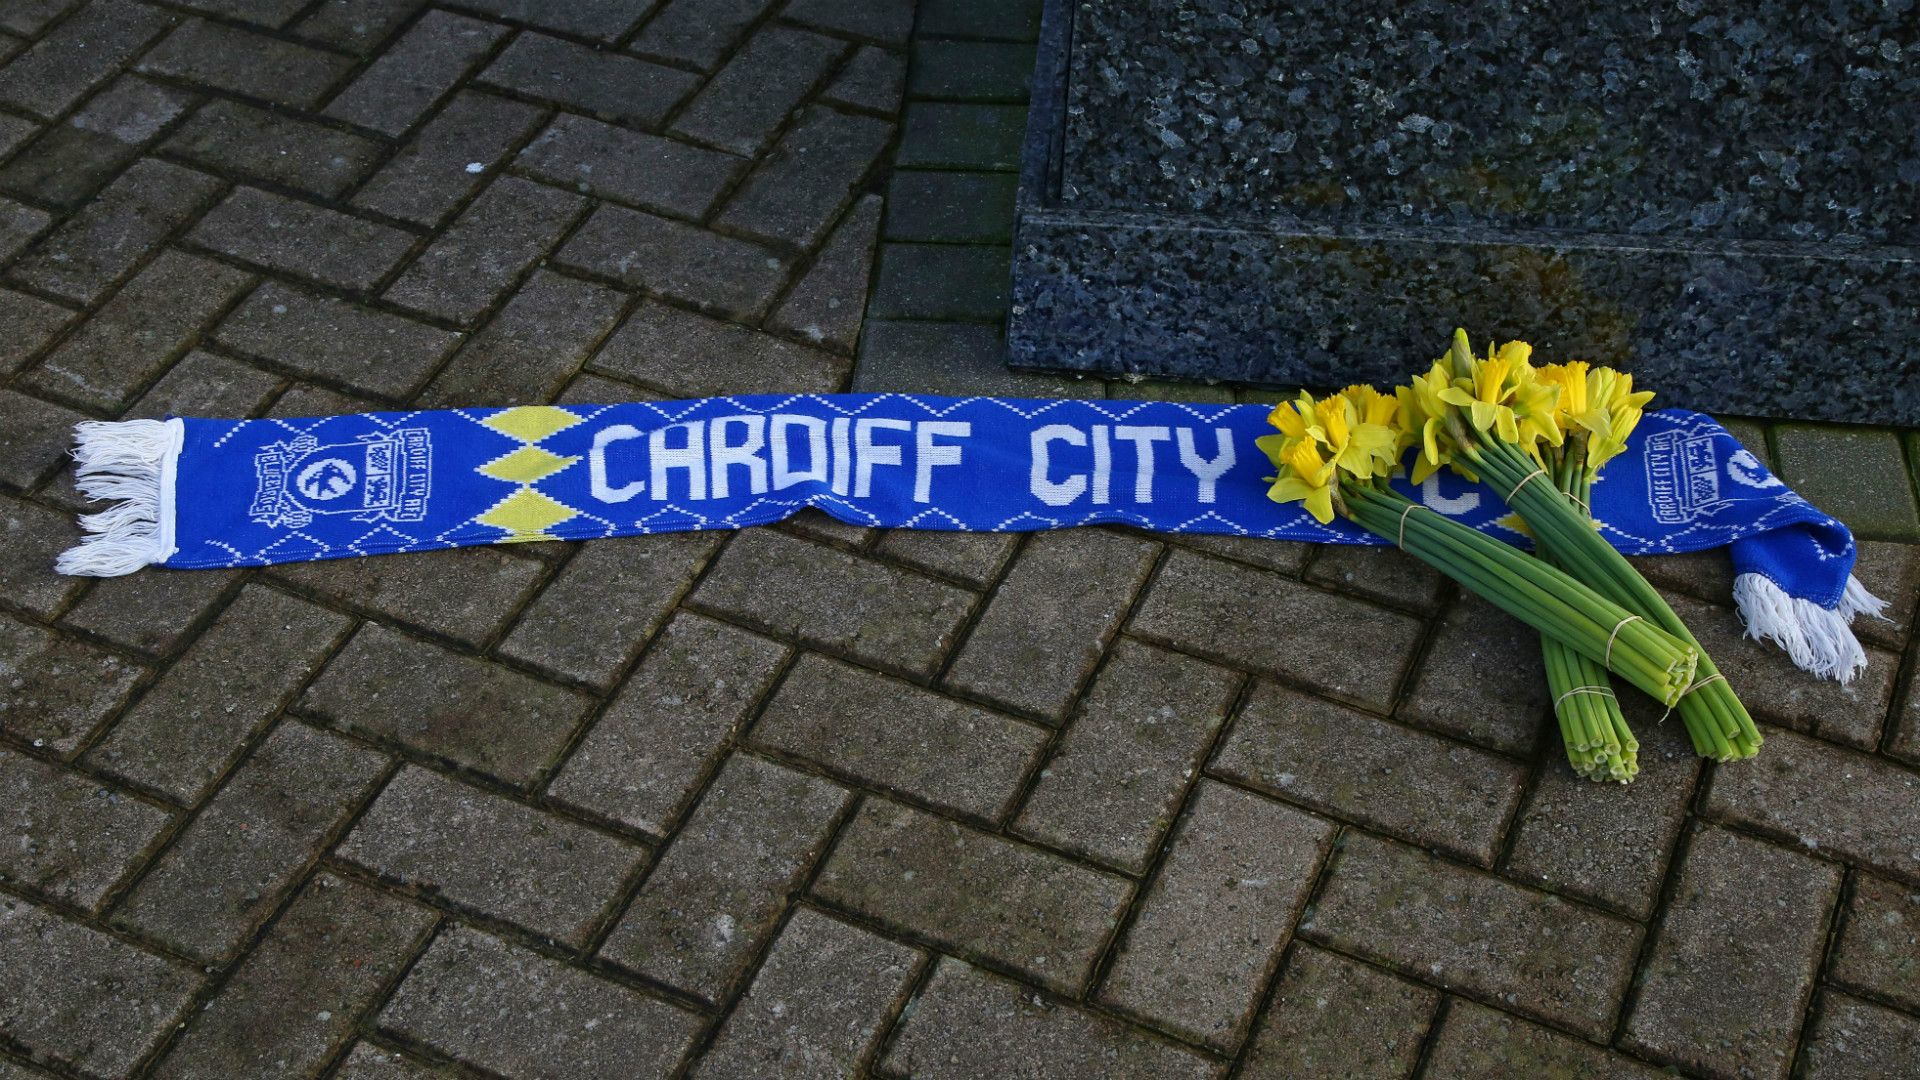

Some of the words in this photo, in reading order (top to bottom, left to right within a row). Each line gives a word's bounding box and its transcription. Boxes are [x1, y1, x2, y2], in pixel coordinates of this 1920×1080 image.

[406, 431, 427, 470] CARDIFF
[1652, 433, 1672, 451] AFC
[588, 414, 970, 504] CARDIFF
[1030, 424, 1237, 506] CITY
[1650, 454, 1671, 477] CITY
[409, 473, 427, 496] CITY
[400, 498, 422, 519] AFC
[1654, 480, 1681, 520] CARDIFF
